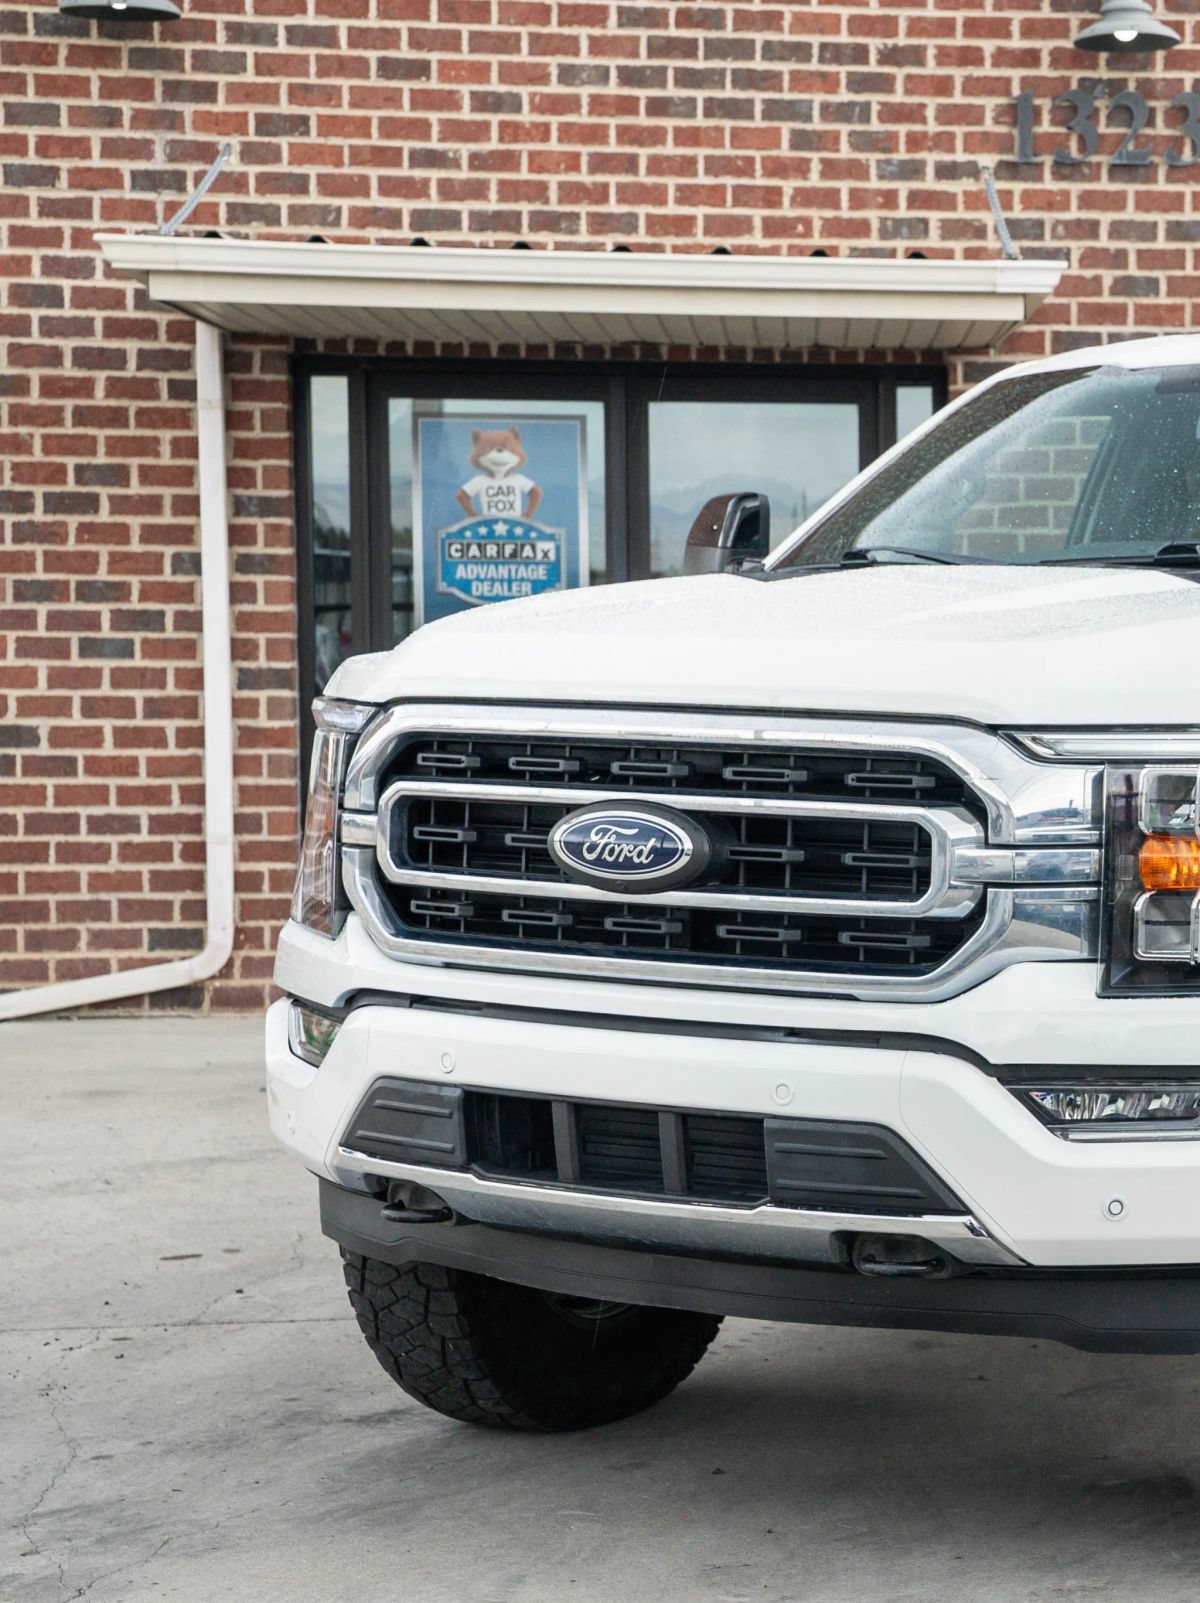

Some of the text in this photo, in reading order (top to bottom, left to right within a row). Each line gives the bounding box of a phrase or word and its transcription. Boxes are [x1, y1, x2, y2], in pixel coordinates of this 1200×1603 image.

[485, 485, 517, 499] CAR
[487, 499, 517, 513] FOX
[449, 543, 554, 561] CARFAX
[455, 564, 548, 580] ADVANTAGE
[471, 581, 532, 597] DEALER
[582, 824, 657, 864] Ford
